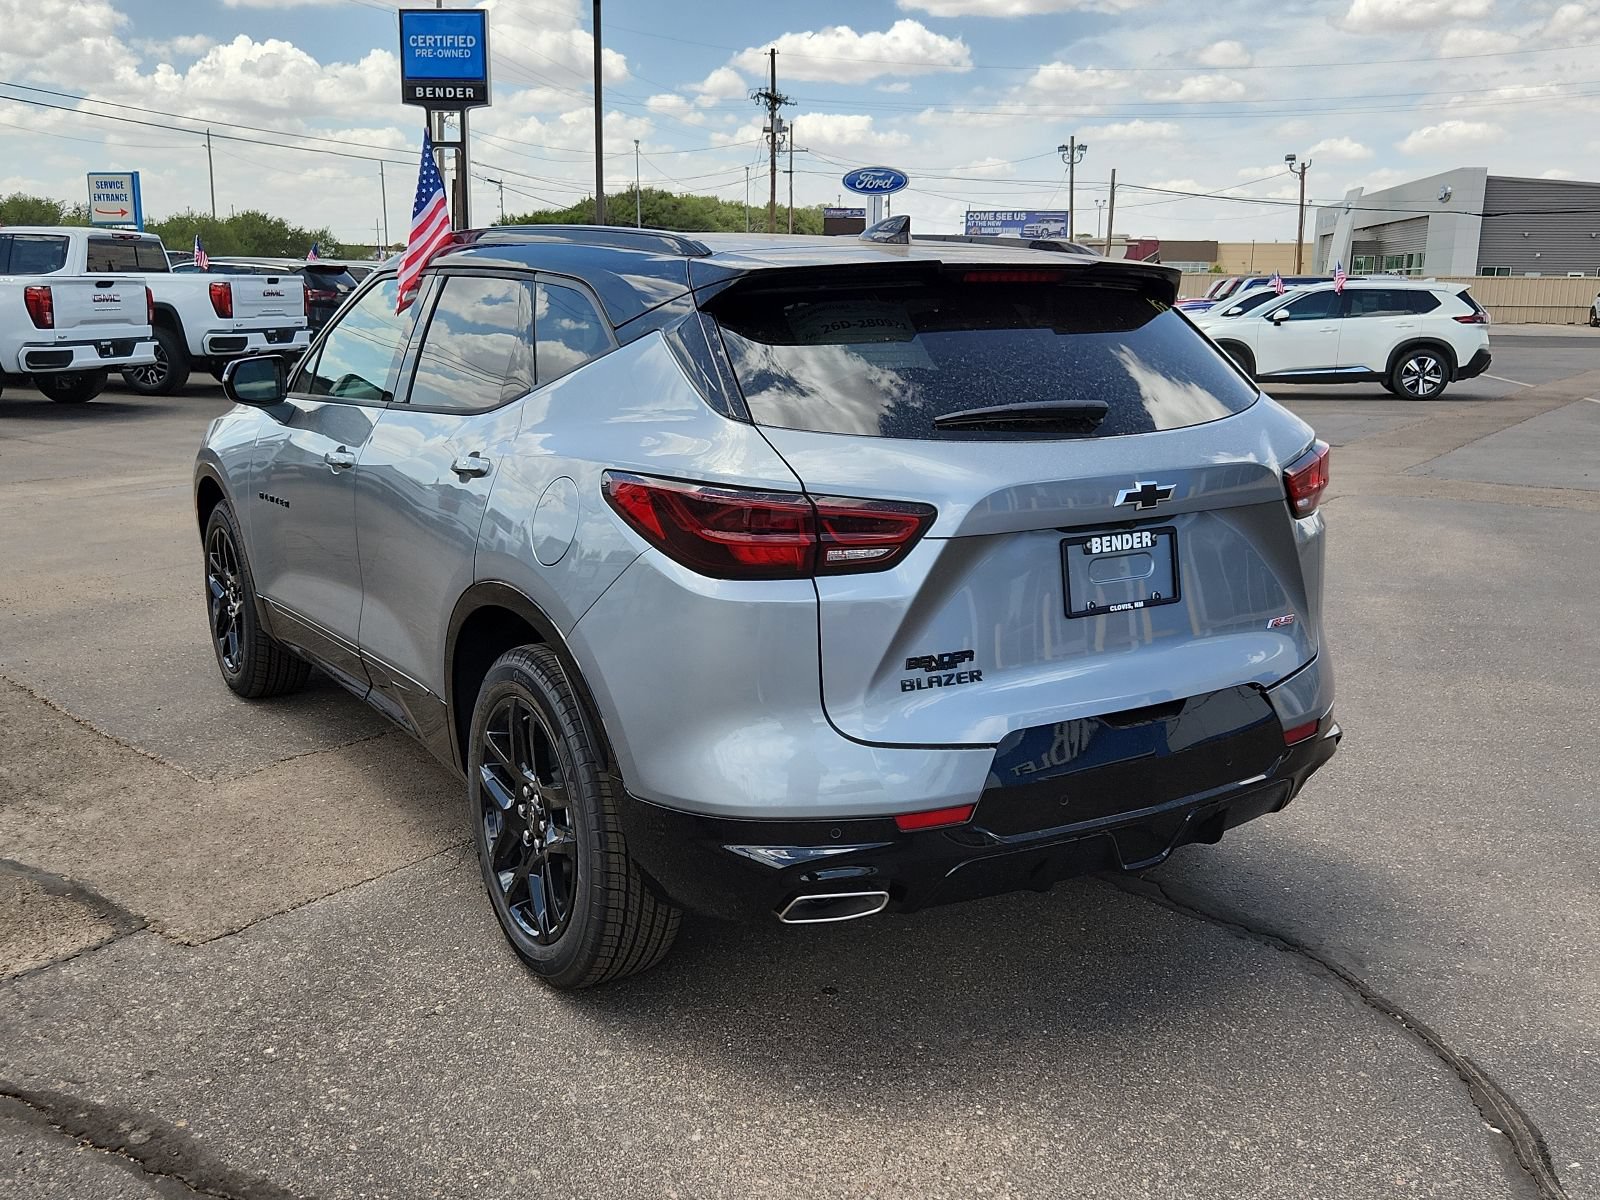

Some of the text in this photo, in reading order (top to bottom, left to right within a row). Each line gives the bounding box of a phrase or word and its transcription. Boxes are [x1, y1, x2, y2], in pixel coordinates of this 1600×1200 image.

[409, 35, 476, 47] CERTIFIED
[415, 49, 471, 58] PRE-OWNED
[415, 87, 474, 98] BENDER
[95, 180, 125, 190] SERVICE
[855, 171, 894, 189] Ford
[93, 193, 129, 202] ENTRANCE
[967, 212, 995, 221] COME
[996, 212, 1013, 221] SEE
[1014, 212, 1027, 221] US
[93, 294, 121, 303] GMC
[1091, 532, 1152, 554] BENDER
[905, 649, 975, 671] BENDER
[900, 669, 983, 692] BLAZER
